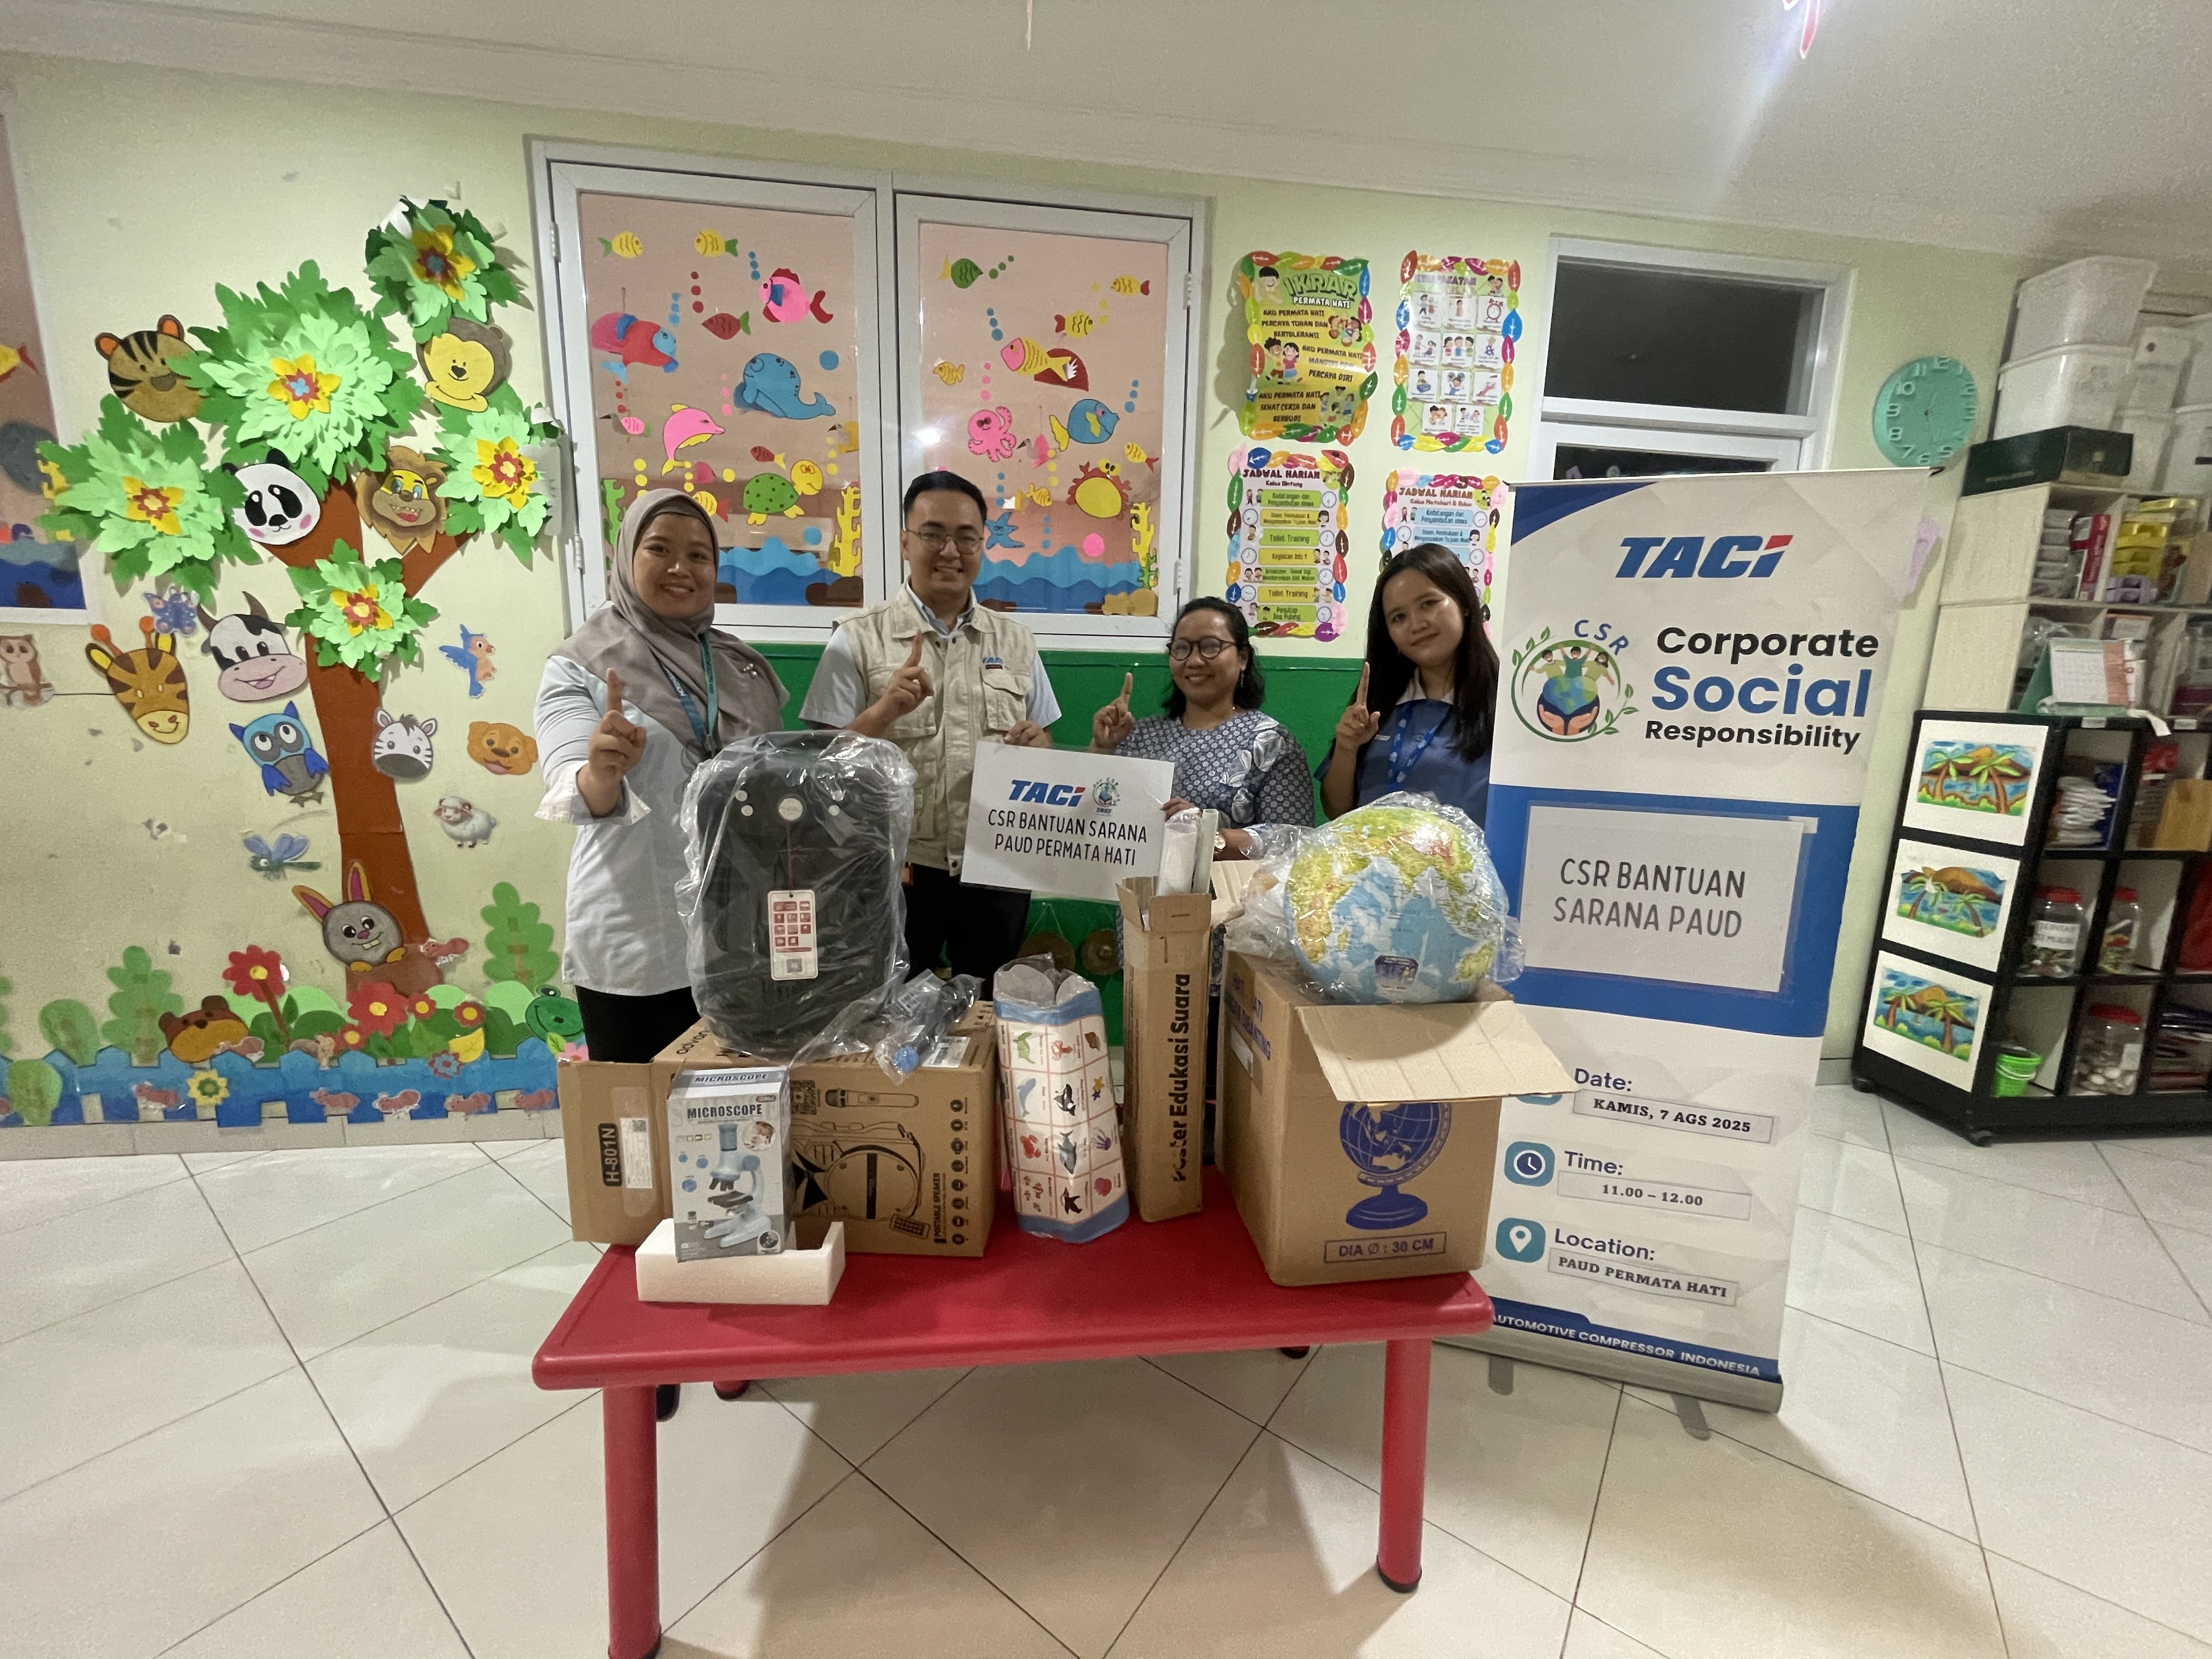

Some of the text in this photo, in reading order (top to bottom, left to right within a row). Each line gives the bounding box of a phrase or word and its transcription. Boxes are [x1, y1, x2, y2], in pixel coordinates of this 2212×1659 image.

[1283, 274, 1357, 301] IKRAR
[1294, 297, 1351, 309] PERMATA HATI
[1317, 347, 1347, 356] PERMATA
[1308, 369, 1353, 382] PERCAYA DIRI
[1889, 426, 1903, 441] 8
[1900, 444, 1916, 459] 7
[1243, 469, 1320, 479] JADWAL HARIAN
[1399, 487, 1473, 499] JADWAL HARIAN
[1288, 534, 1310, 544] Training
[1286, 590, 1308, 599] Training
[1574, 619, 1629, 656] CSR
[1657, 627, 1879, 664] Corporate
[1651, 663, 1872, 718] Social
[1645, 721, 1860, 754] Responsibility
[988, 809, 1147, 843] CSR BANTUAN SARANA
[995, 833, 1136, 866] PAUD PERMATA HATI
[1560, 858, 1745, 899] CSR BANTUAN
[1553, 896, 1742, 938] SARANA PAUD
[1170, 974, 1190, 1034] Suara
[695, 1074, 767, 1083] MICROSCOPE
[1167, 1039, 1189, 1116] Edukasi
[1574, 1068, 1633, 1092] Date:
[687, 1104, 763, 1119] MICROSCOPE
[1593, 1099, 1751, 1132] KAMIS, 7 AGS 2025
[602, 1128, 619, 1182] H-801N
[1564, 1150, 1623, 1175] Time:
[1603, 1184, 1644, 1198] 11.00
[1661, 1192, 1703, 1206] 12.00
[933, 1206, 941, 1237] PORTABLE
[1339, 1245, 1363, 1256] DIA
[1392, 1241, 1408, 1252] 30
[1412, 1238, 1434, 1251] CM
[1554, 1228, 1655, 1261] Location:
[1558, 1256, 1727, 1298] PAUD PERMATA HATI
[1579, 1331, 1675, 1358] COMPRESSOR
[1681, 1352, 1760, 1376] INDONESIA
